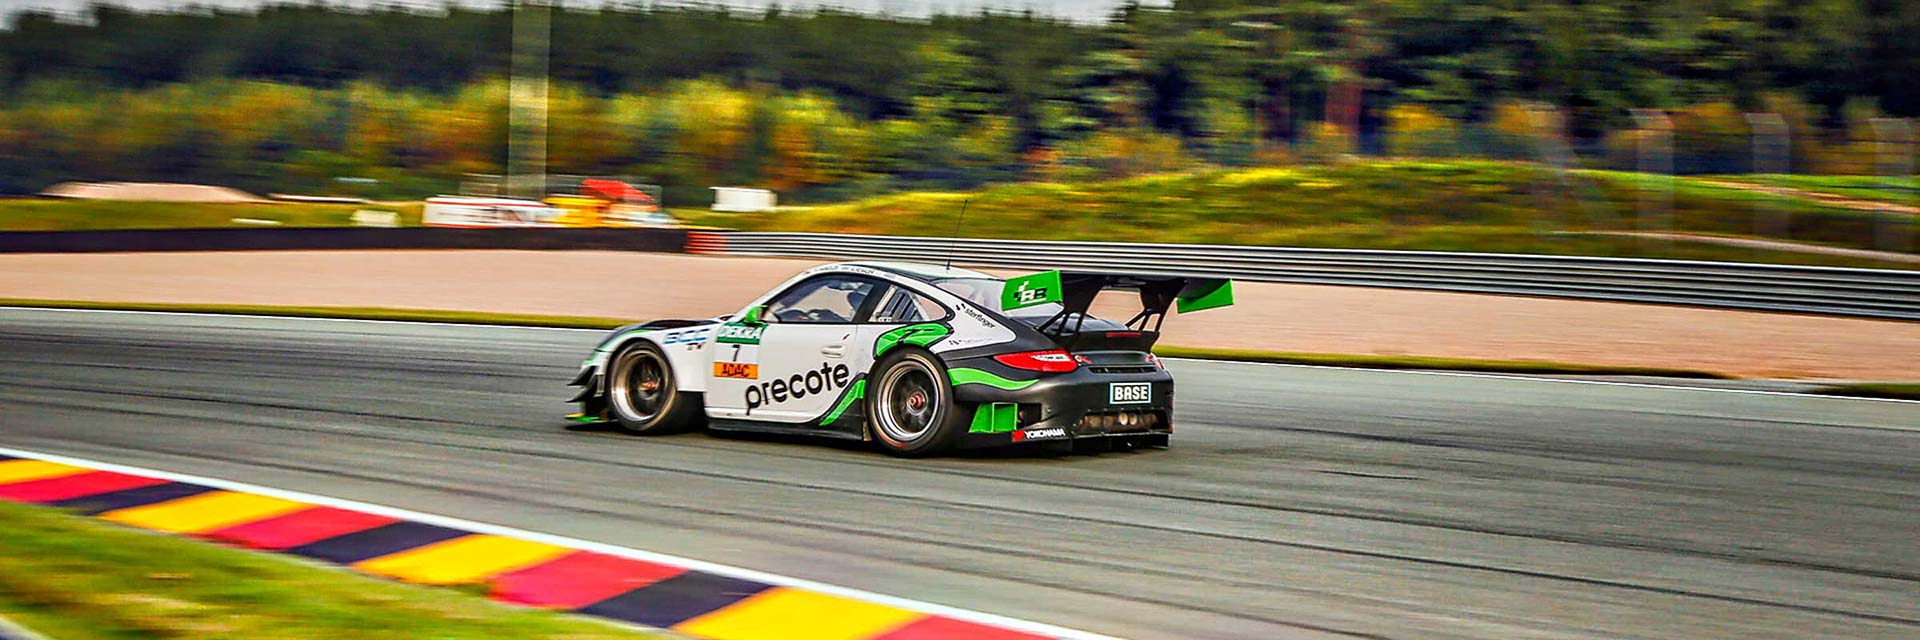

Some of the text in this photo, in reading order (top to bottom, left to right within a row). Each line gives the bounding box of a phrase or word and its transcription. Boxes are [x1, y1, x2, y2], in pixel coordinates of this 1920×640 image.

[731, 344, 741, 362] 7
[745, 361, 850, 416] precote
[1114, 386, 1149, 401] BASE
